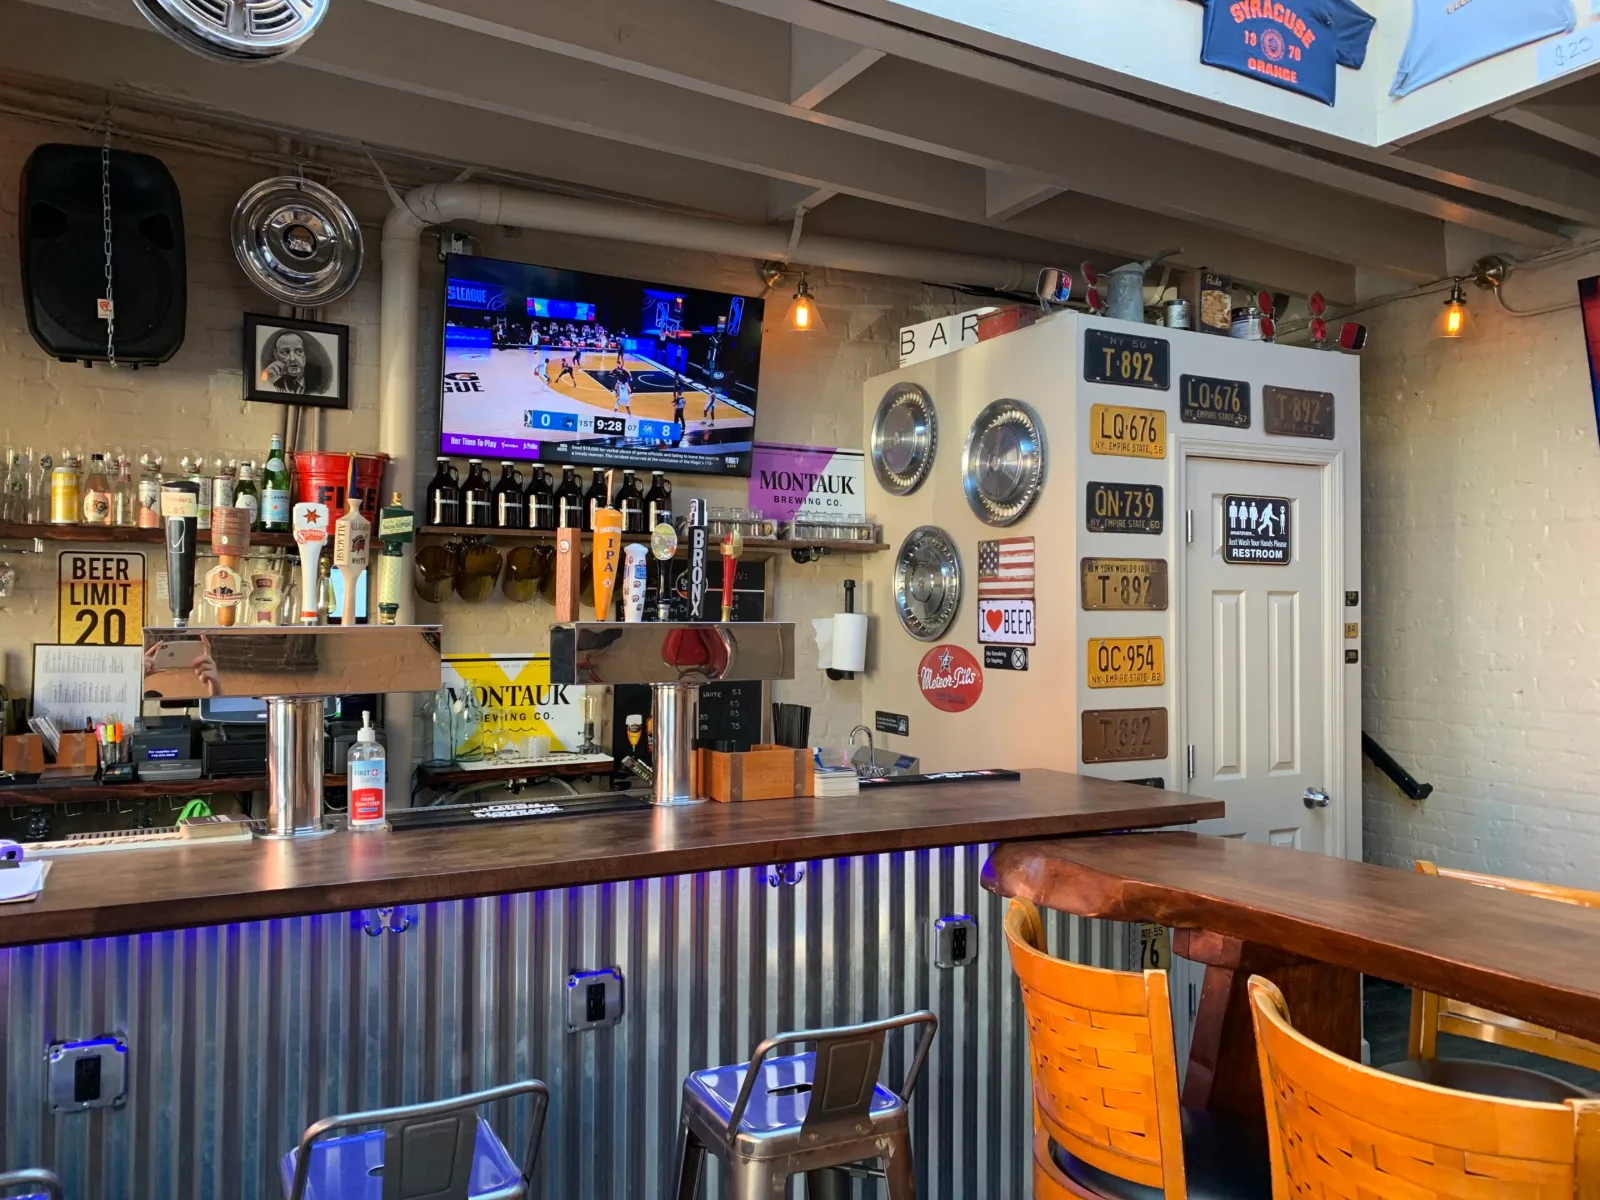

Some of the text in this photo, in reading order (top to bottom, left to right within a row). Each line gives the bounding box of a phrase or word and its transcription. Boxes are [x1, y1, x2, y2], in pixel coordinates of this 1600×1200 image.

[1230, 0, 1316, 49] SYRACUSE
[1288, 45, 1301, 61] 70
[1555, 36, 1594, 66] $25
[1247, 57, 1298, 83] ORANGE
[456, 287, 487, 303] LEAGUE
[900, 314, 979, 355] BAR
[1110, 337, 1124, 345] NY
[541, 414, 550, 426] 0
[579, 420, 594, 428] 1ST
[597, 420, 622, 431] 9:28
[662, 425, 670, 437] 8
[1197, 410, 1217, 419] EMPIRE
[1218, 412, 1234, 421] STATE
[462, 437, 476, 446] Time
[477, 438, 484, 447] To
[484, 439, 497, 449] Play
[1095, 441, 1104, 449] NY
[1108, 441, 1130, 452] EMPIRE
[760, 470, 855, 495] MONTAUK
[774, 496, 842, 507] BREWING CO.
[1090, 518, 1160, 529] NY EMPIRE STATE 60
[1228, 538, 1287, 548] Just Wash Your Hands Please
[1232, 548, 1283, 559] RESTROOM
[603, 538, 615, 572] IPA
[72, 557, 129, 580] BEER
[690, 529, 704, 617] BRONX
[1101, 564, 1114, 573] YORK
[70, 583, 131, 605] LIMIT
[75, 608, 126, 645] 20
[981, 609, 1032, 634] I BEER
[921, 666, 976, 690] Meteor-Pils
[1106, 674, 1127, 683] EMPIRE
[1130, 673, 1147, 682] STATE
[1151, 672, 1161, 681] 62
[447, 684, 570, 708] MONTAUK
[534, 712, 554, 720] CO.
[360, 776, 381, 784] Safety
[1141, 939, 1160, 969] 76
